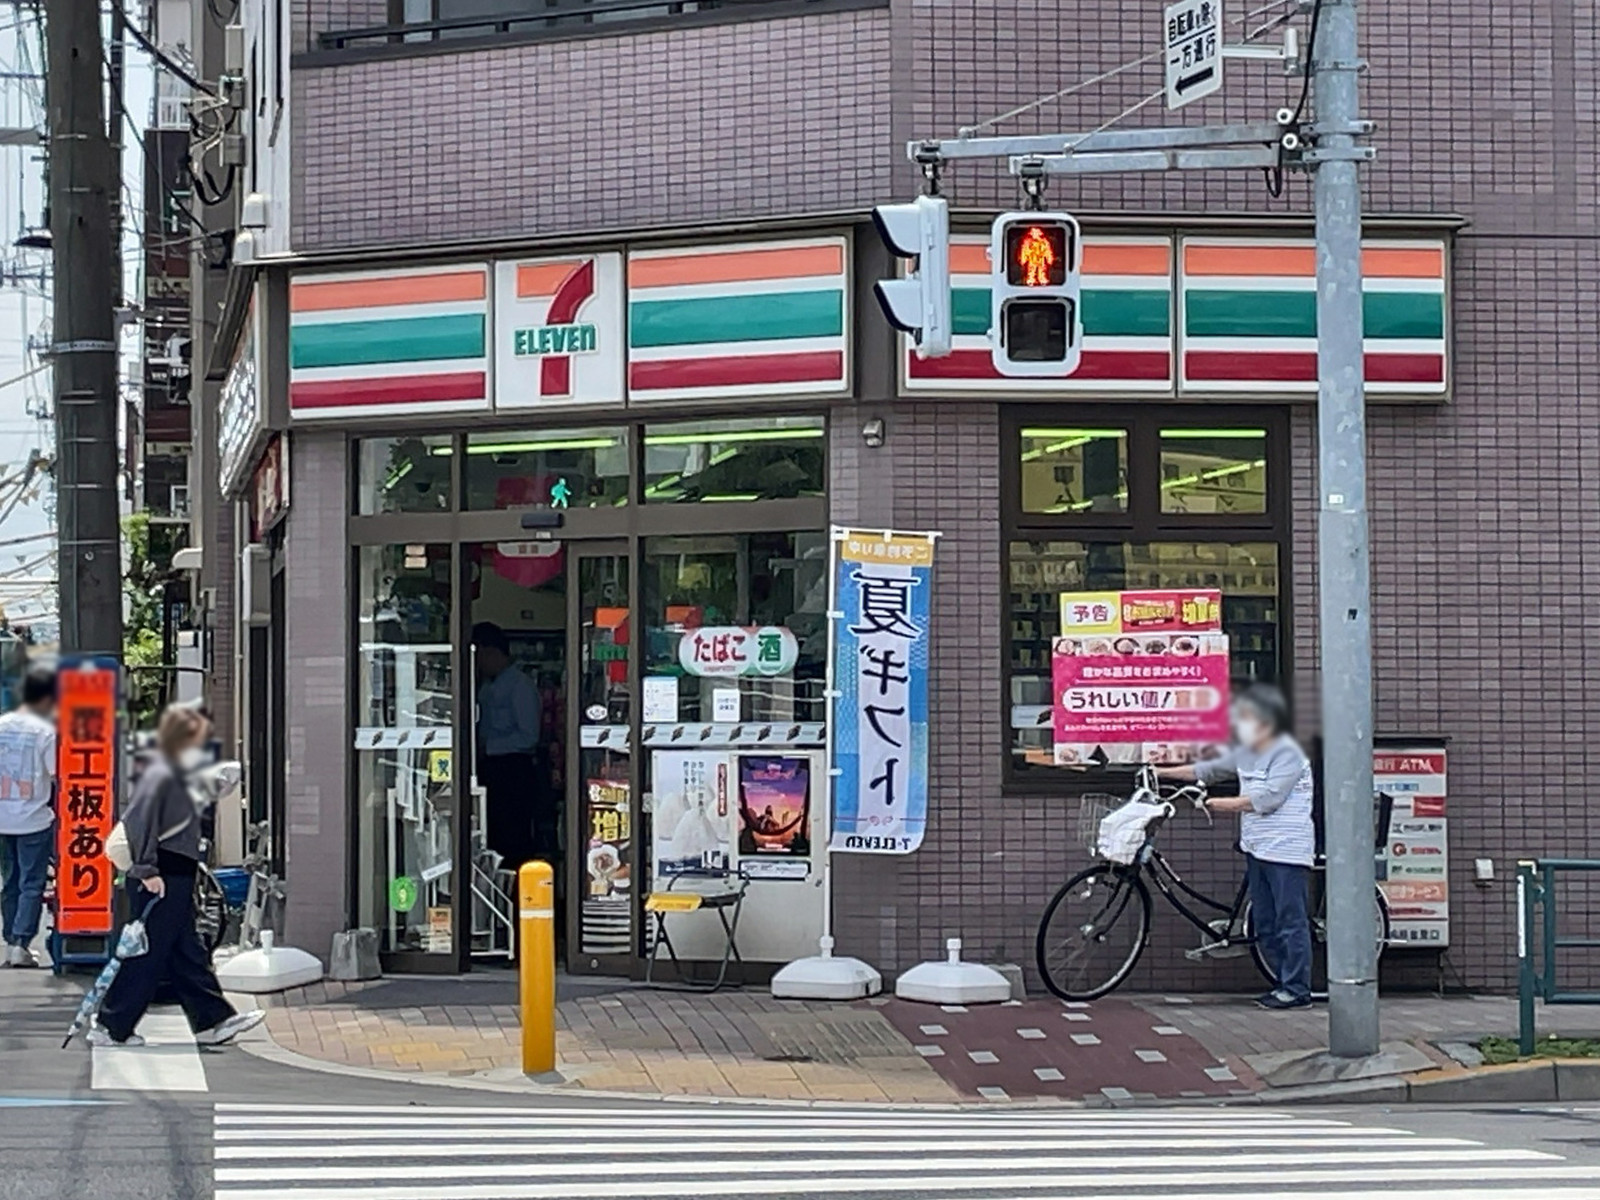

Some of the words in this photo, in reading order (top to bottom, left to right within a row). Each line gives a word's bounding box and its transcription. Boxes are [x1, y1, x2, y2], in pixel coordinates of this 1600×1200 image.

[1170, 33, 1216, 69] 一方通行
[517, 259, 595, 396] 7
[1072, 604, 1109, 623] 予告
[693, 633, 747, 662] たばこ
[758, 634, 782, 662] 酒
[1399, 758, 1433, 772] ATM
